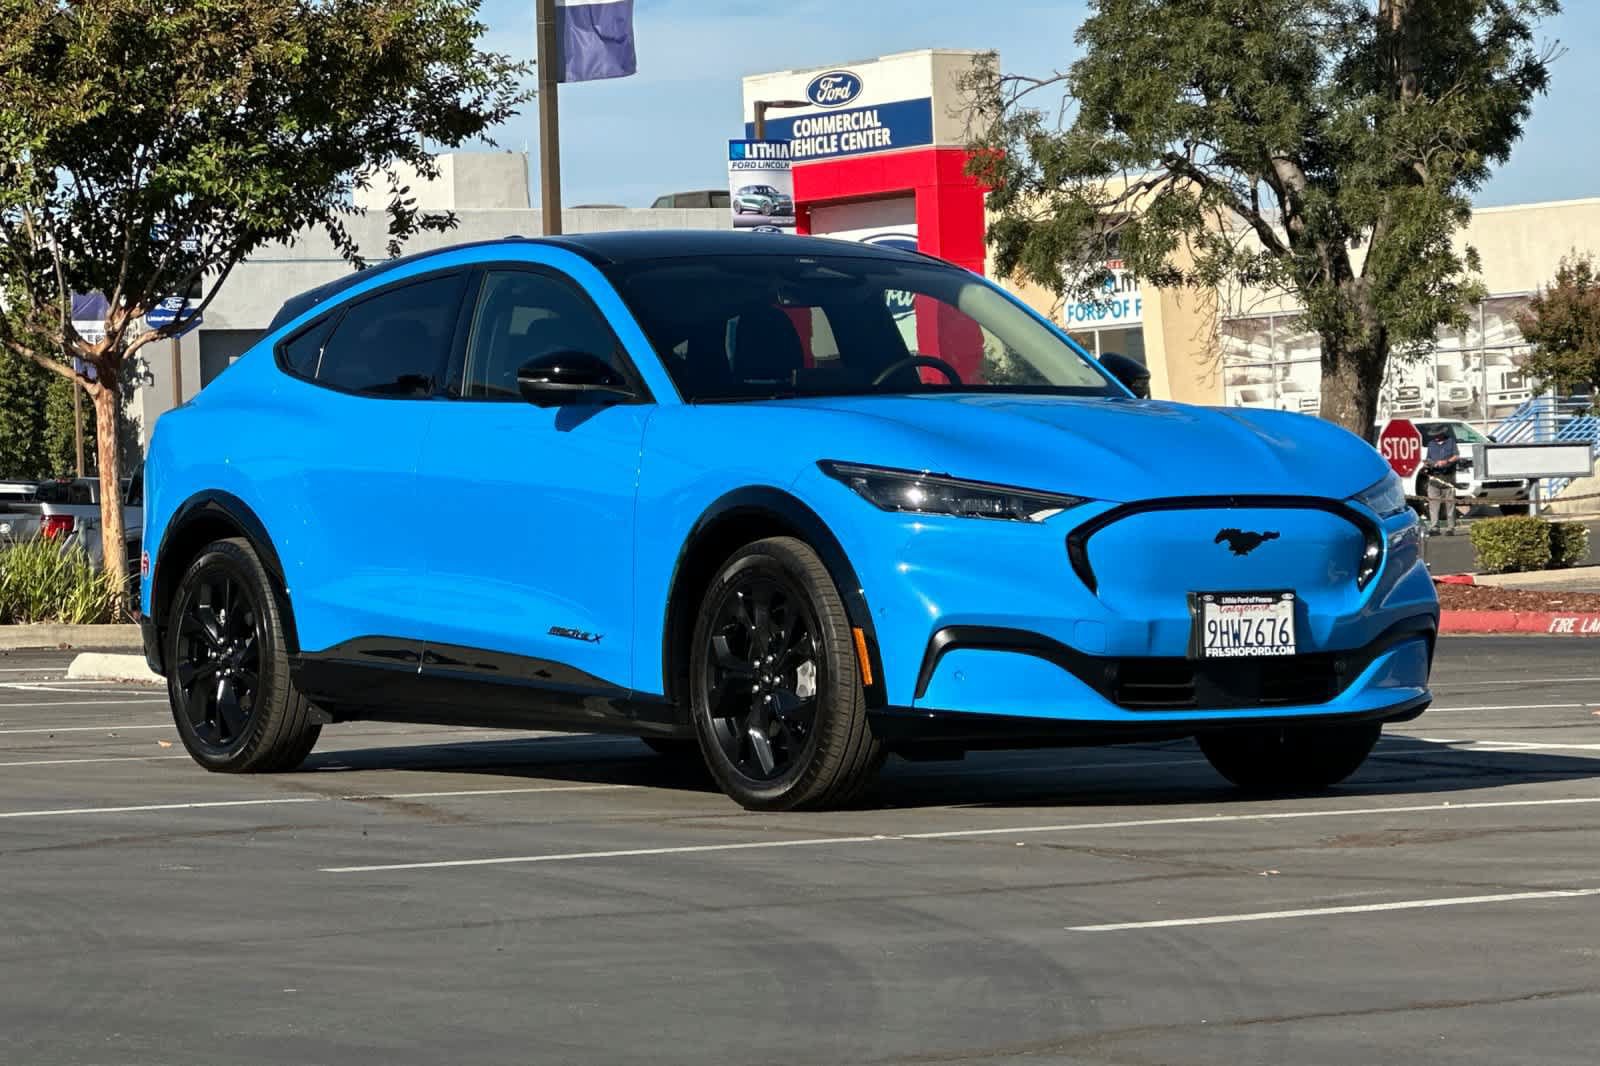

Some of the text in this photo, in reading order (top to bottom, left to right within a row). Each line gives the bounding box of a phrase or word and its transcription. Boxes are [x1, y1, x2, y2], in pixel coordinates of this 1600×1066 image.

[816, 76, 851, 102] Ford
[793, 110, 882, 138] COMMERCIAL
[745, 143, 790, 159] LITHIA
[840, 128, 892, 152] CENTER
[732, 161, 790, 169] FORD LINCOLN
[1067, 302, 1107, 322] FORD
[1111, 299, 1130, 319] OF
[1383, 438, 1420, 460] STOP
[1207, 617, 1290, 647] 9HWZ676
[1549, 617, 1579, 633] FIRE
[1205, 645, 1296, 657] FRESNOFORD.COM
